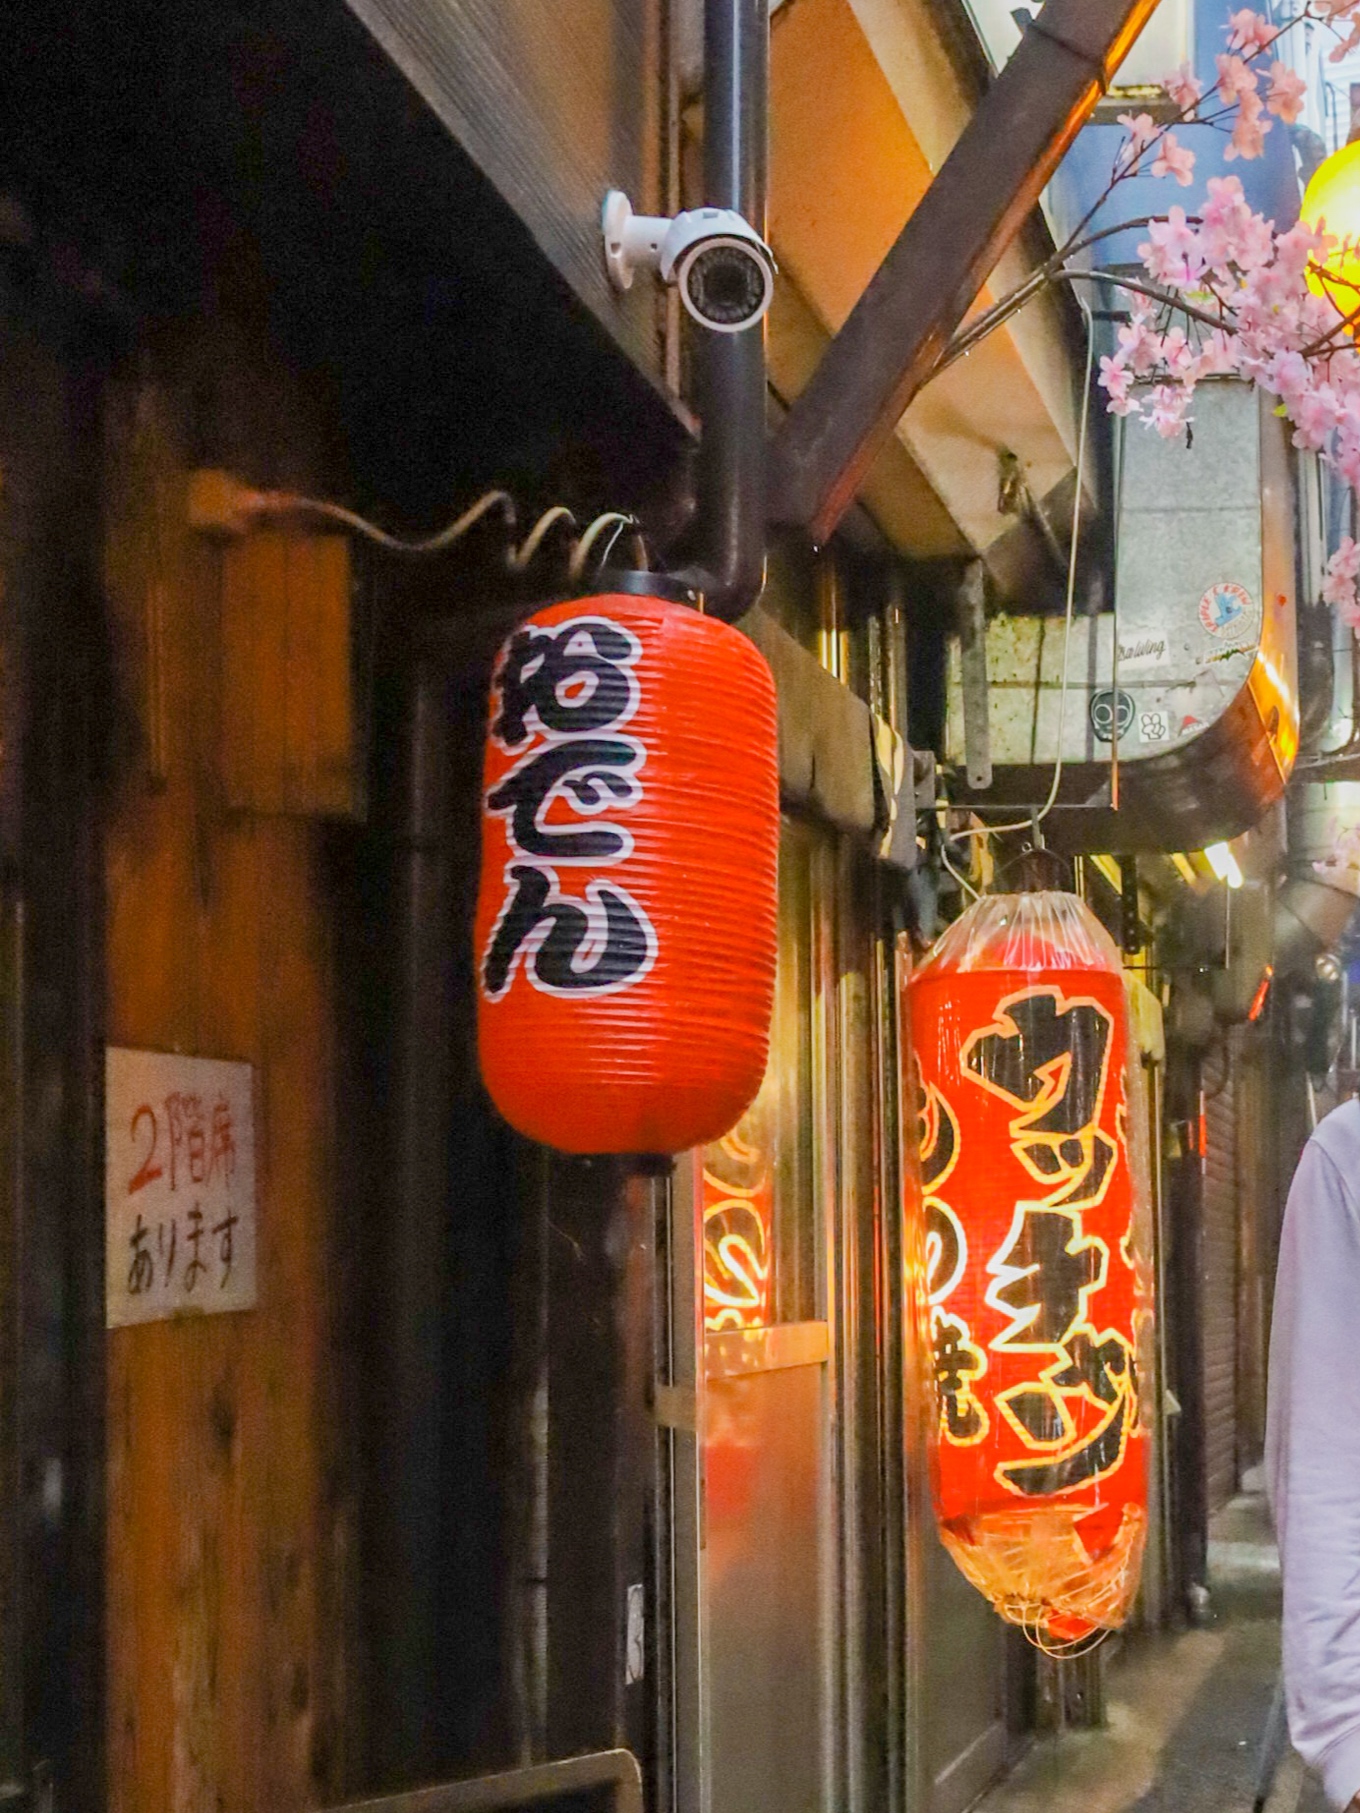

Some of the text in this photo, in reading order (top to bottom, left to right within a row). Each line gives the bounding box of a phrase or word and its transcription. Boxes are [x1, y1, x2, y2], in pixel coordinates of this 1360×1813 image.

[481, 615, 658, 1004] おでん
[127, 1202, 239, 1295] あります
